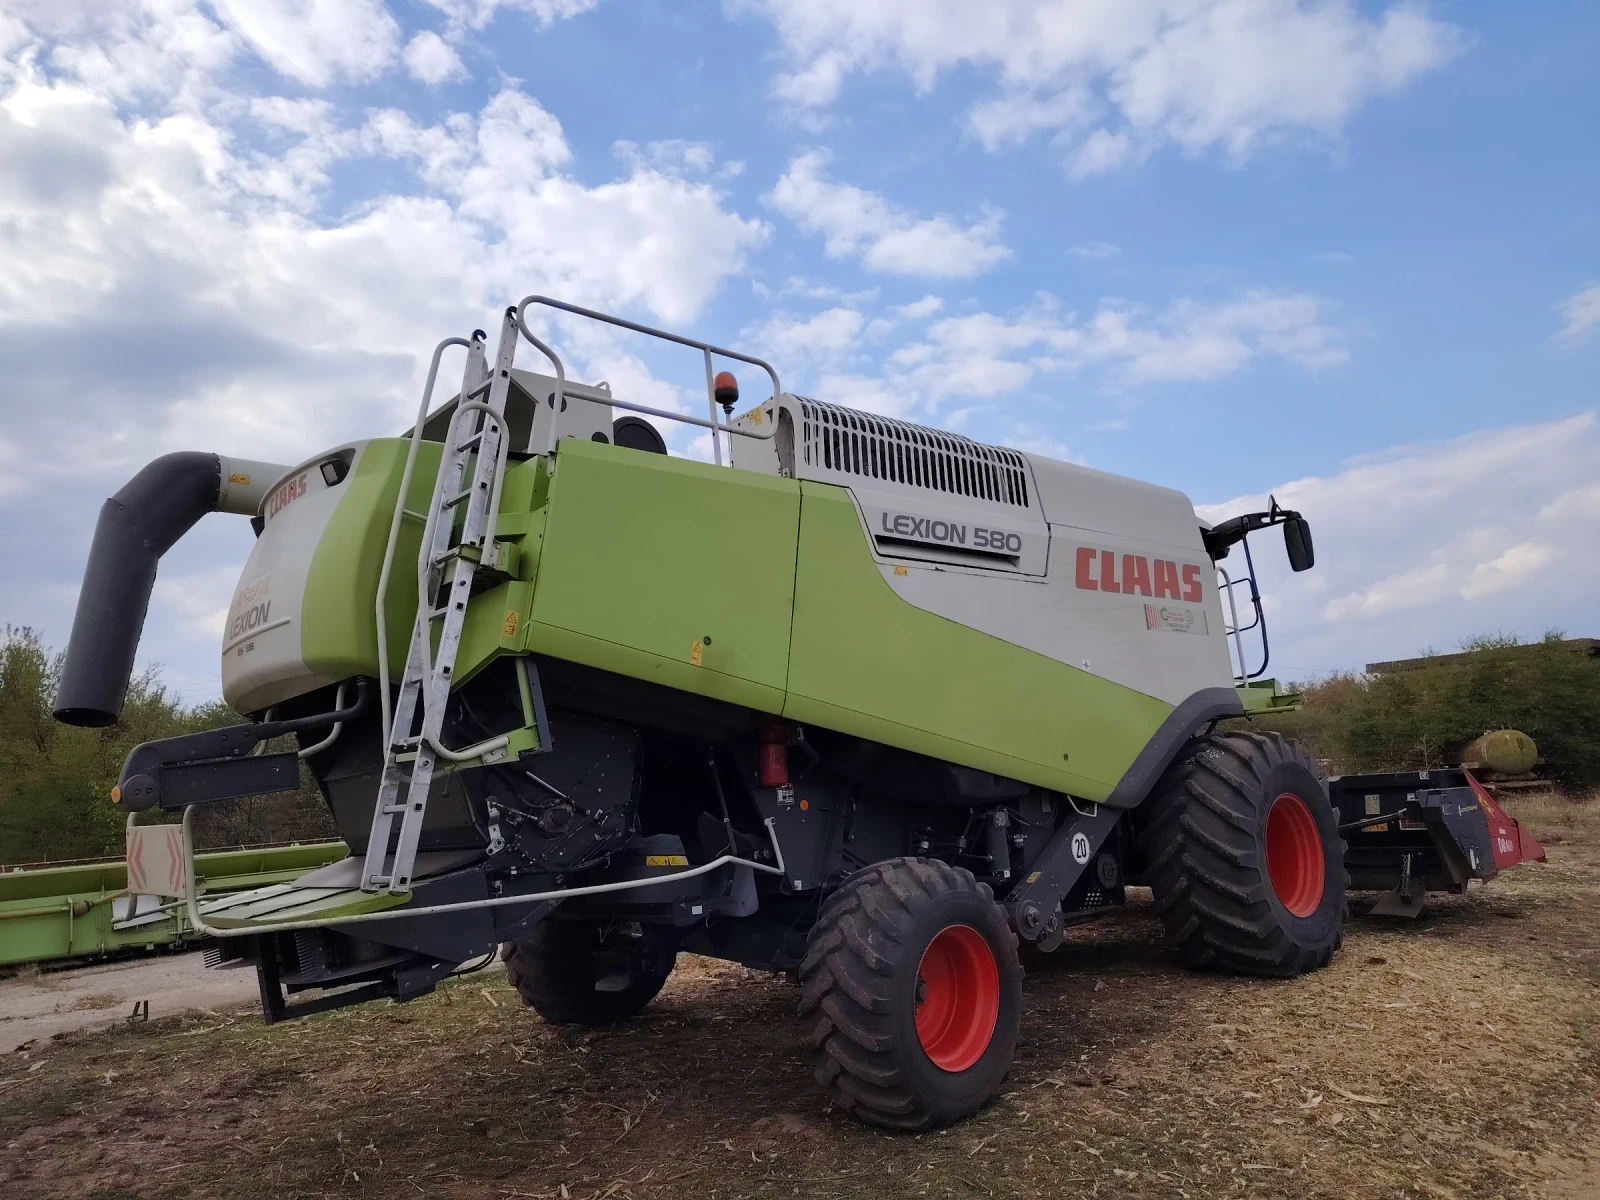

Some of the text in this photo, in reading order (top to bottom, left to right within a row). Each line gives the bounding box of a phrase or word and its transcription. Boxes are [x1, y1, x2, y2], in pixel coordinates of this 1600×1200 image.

[270, 473, 307, 520] CLAAS
[882, 512, 1022, 553] LEXION 580
[1075, 547, 1203, 603] CLAAS
[230, 600, 271, 641] LEXION
[1074, 838, 1087, 858] 20
